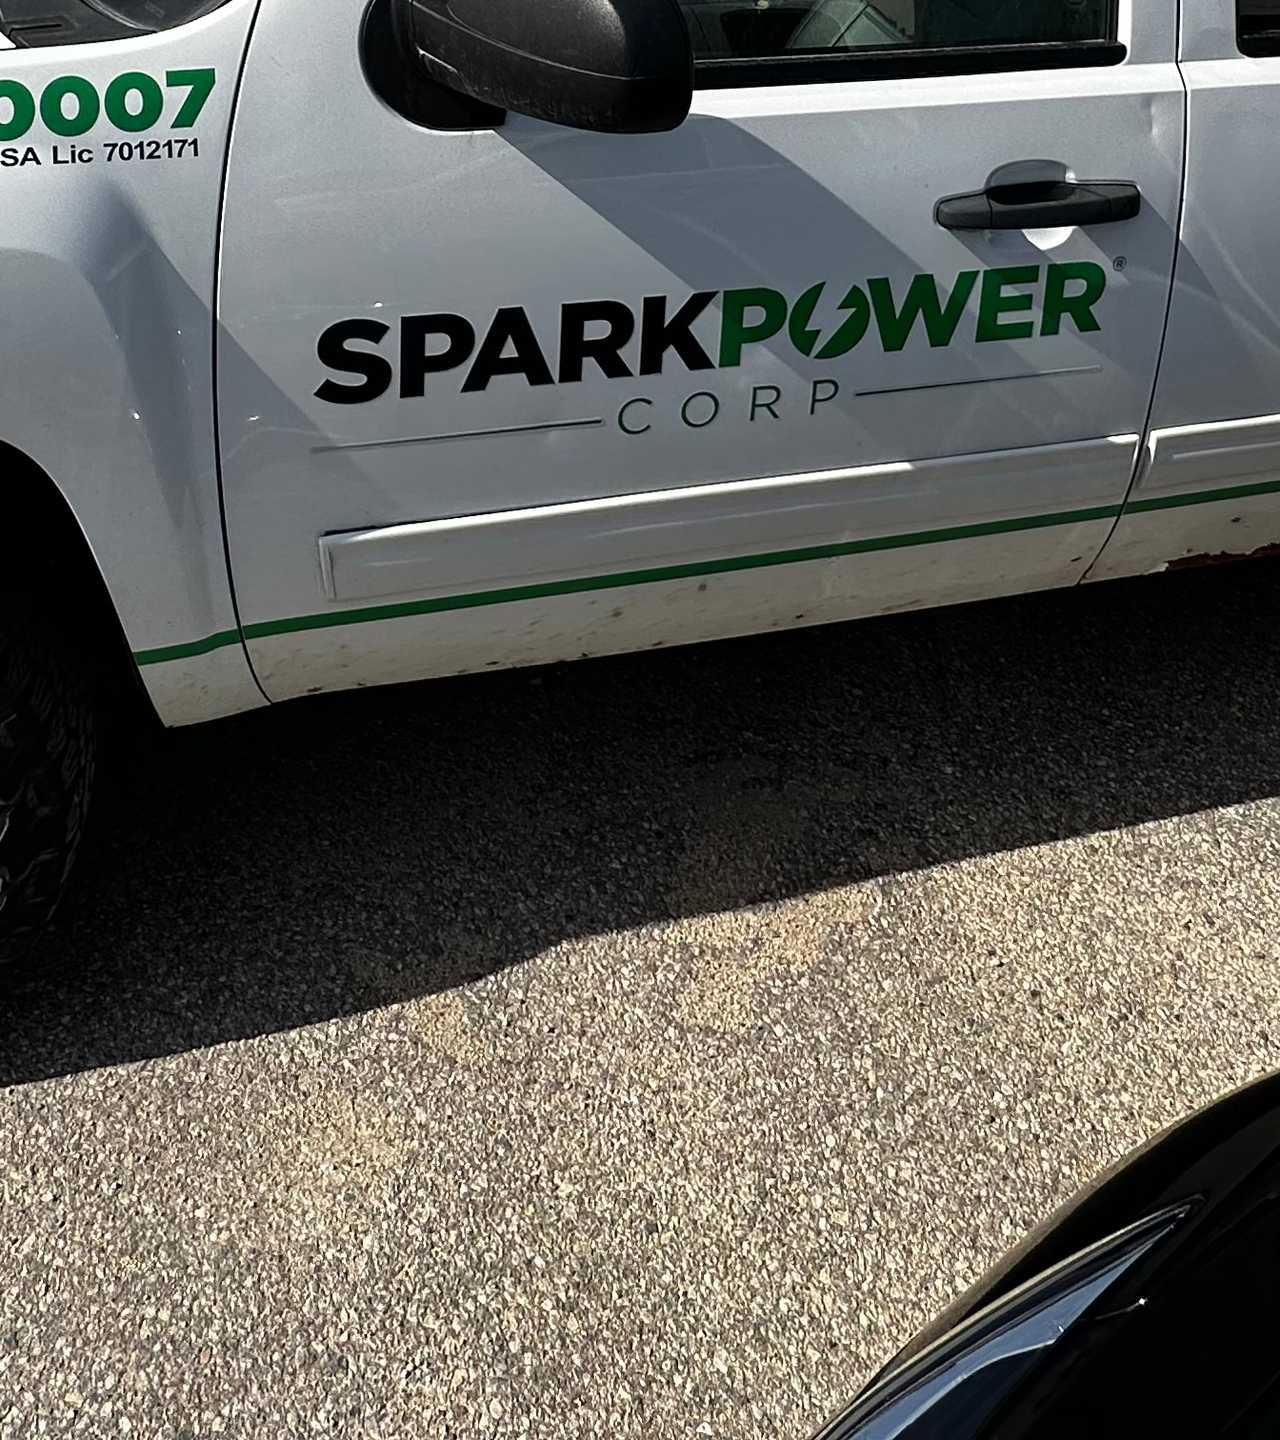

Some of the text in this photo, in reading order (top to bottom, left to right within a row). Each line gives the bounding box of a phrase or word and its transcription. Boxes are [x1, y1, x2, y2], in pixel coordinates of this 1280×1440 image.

[52, 145, 94, 165] Lic
[103, 138, 200, 162] 7012171
[617, 378, 840, 436] CORP
